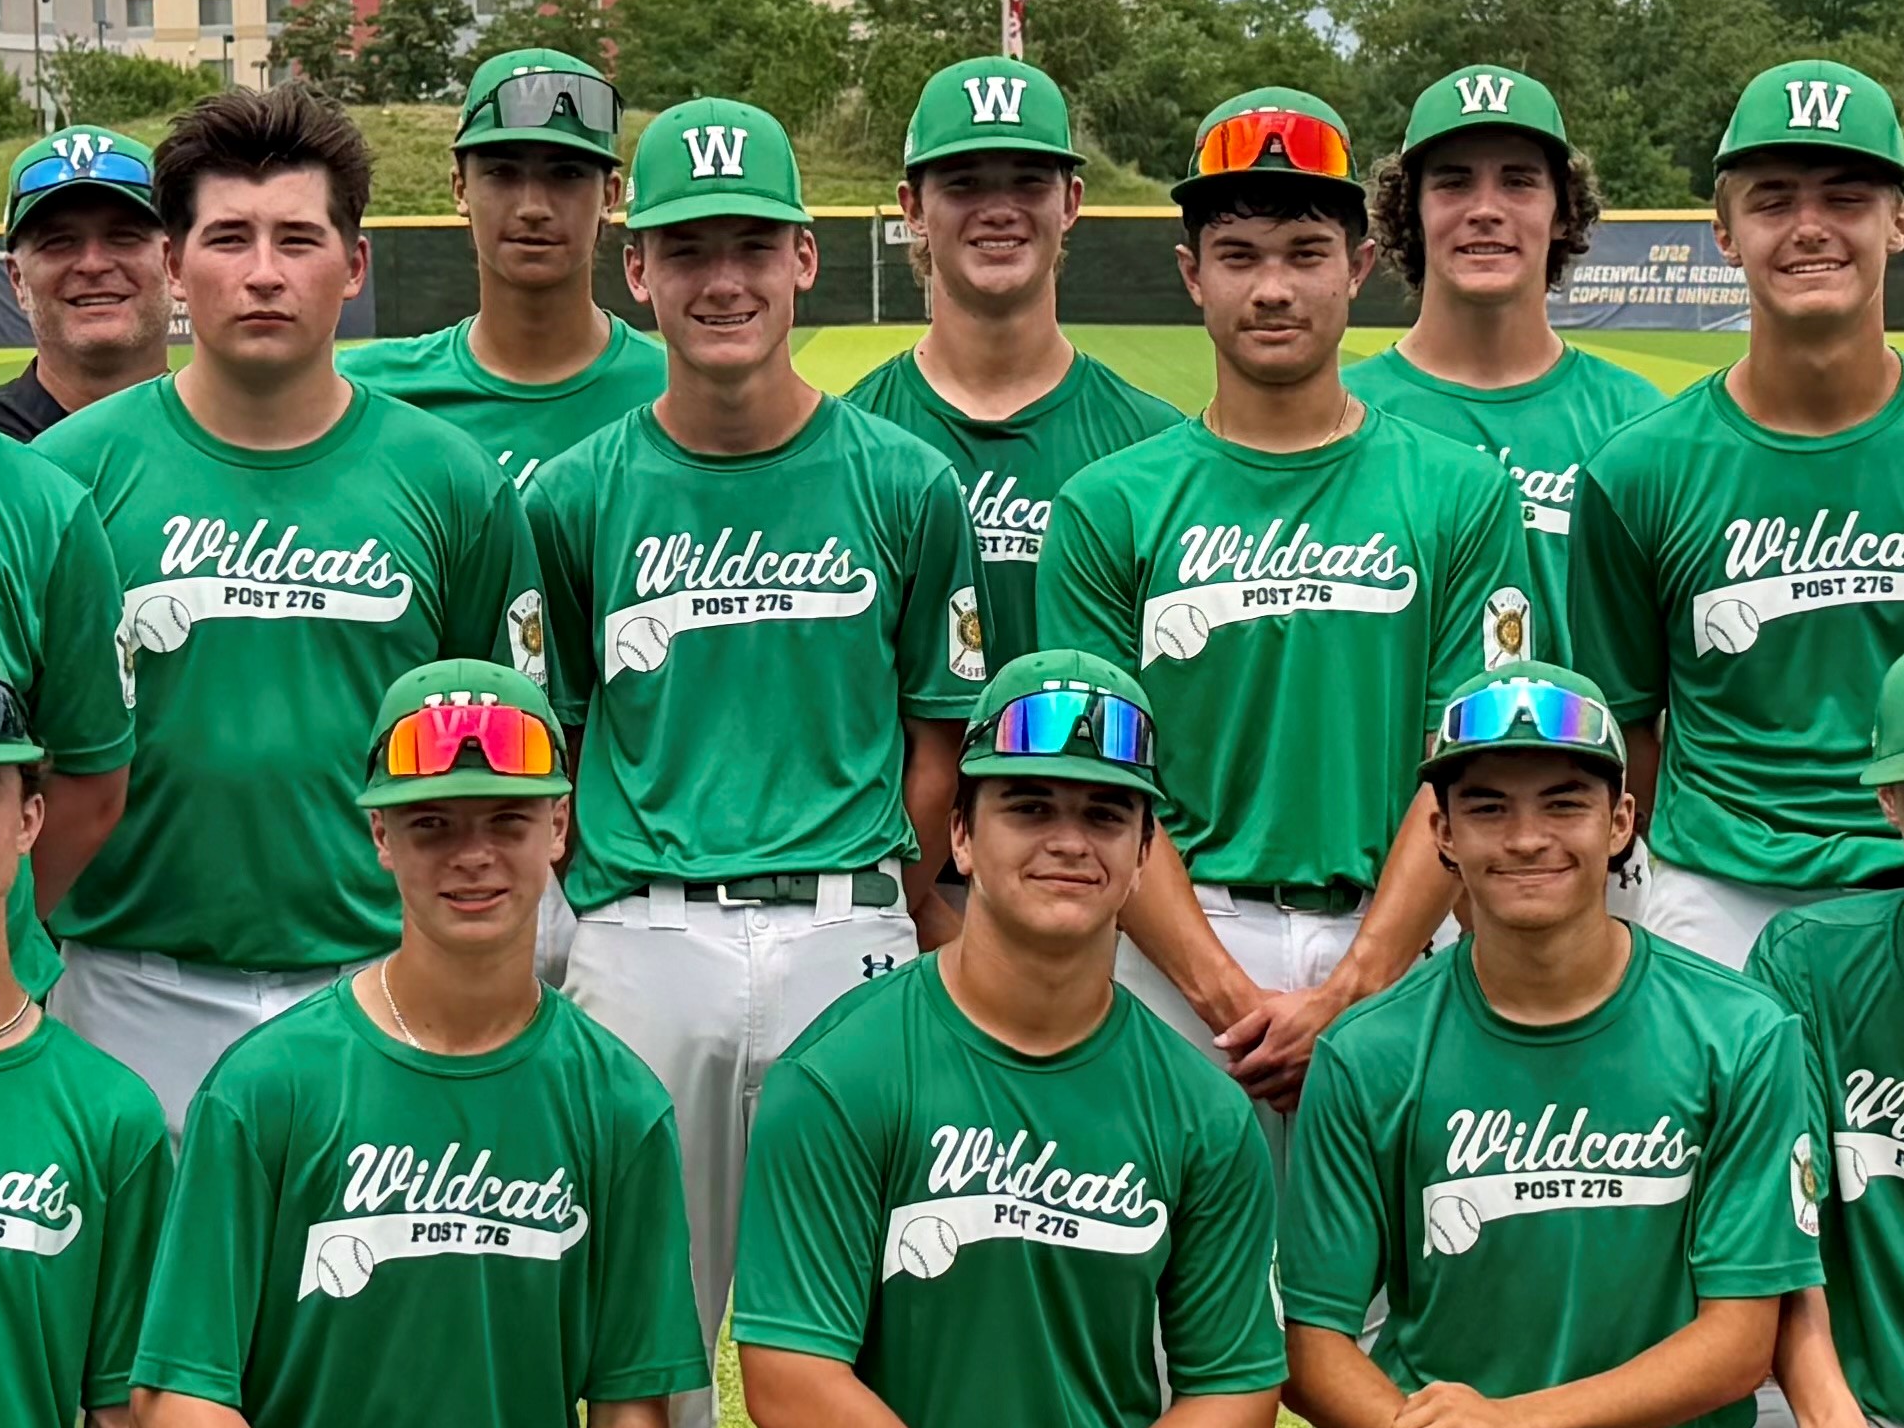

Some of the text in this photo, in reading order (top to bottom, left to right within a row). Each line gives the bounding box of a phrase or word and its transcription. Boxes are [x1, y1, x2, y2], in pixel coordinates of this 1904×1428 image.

[963, 75, 1028, 122] W
[1455, 74, 1515, 114] W
[1785, 80, 1852, 131] W
[52, 133, 114, 172] W
[682, 125, 748, 177] W
[1665, 266, 1687, 283] NC
[1569, 287, 1625, 304] COPPIN
[1627, 287, 1675, 304] STATE
[160, 514, 395, 590] Wildcats
[635, 527, 859, 597] Wildcats
[977, 535, 1040, 555] ST 276
[1176, 519, 1404, 584] Wildcats
[223, 586, 327, 612] POST 276
[691, 594, 794, 616] POST 276
[1241, 583, 1333, 607] POST 276
[1791, 575, 1895, 600] POST 276
[1446, 1104, 1694, 1175] Wildcats
[343, 1142, 573, 1221] Wildcats
[927, 1124, 1151, 1220] Wildcats
[1514, 1178, 1623, 1200] POST 276
[411, 1222, 468, 1245] POST
[1035, 1213, 1080, 1238] 276
